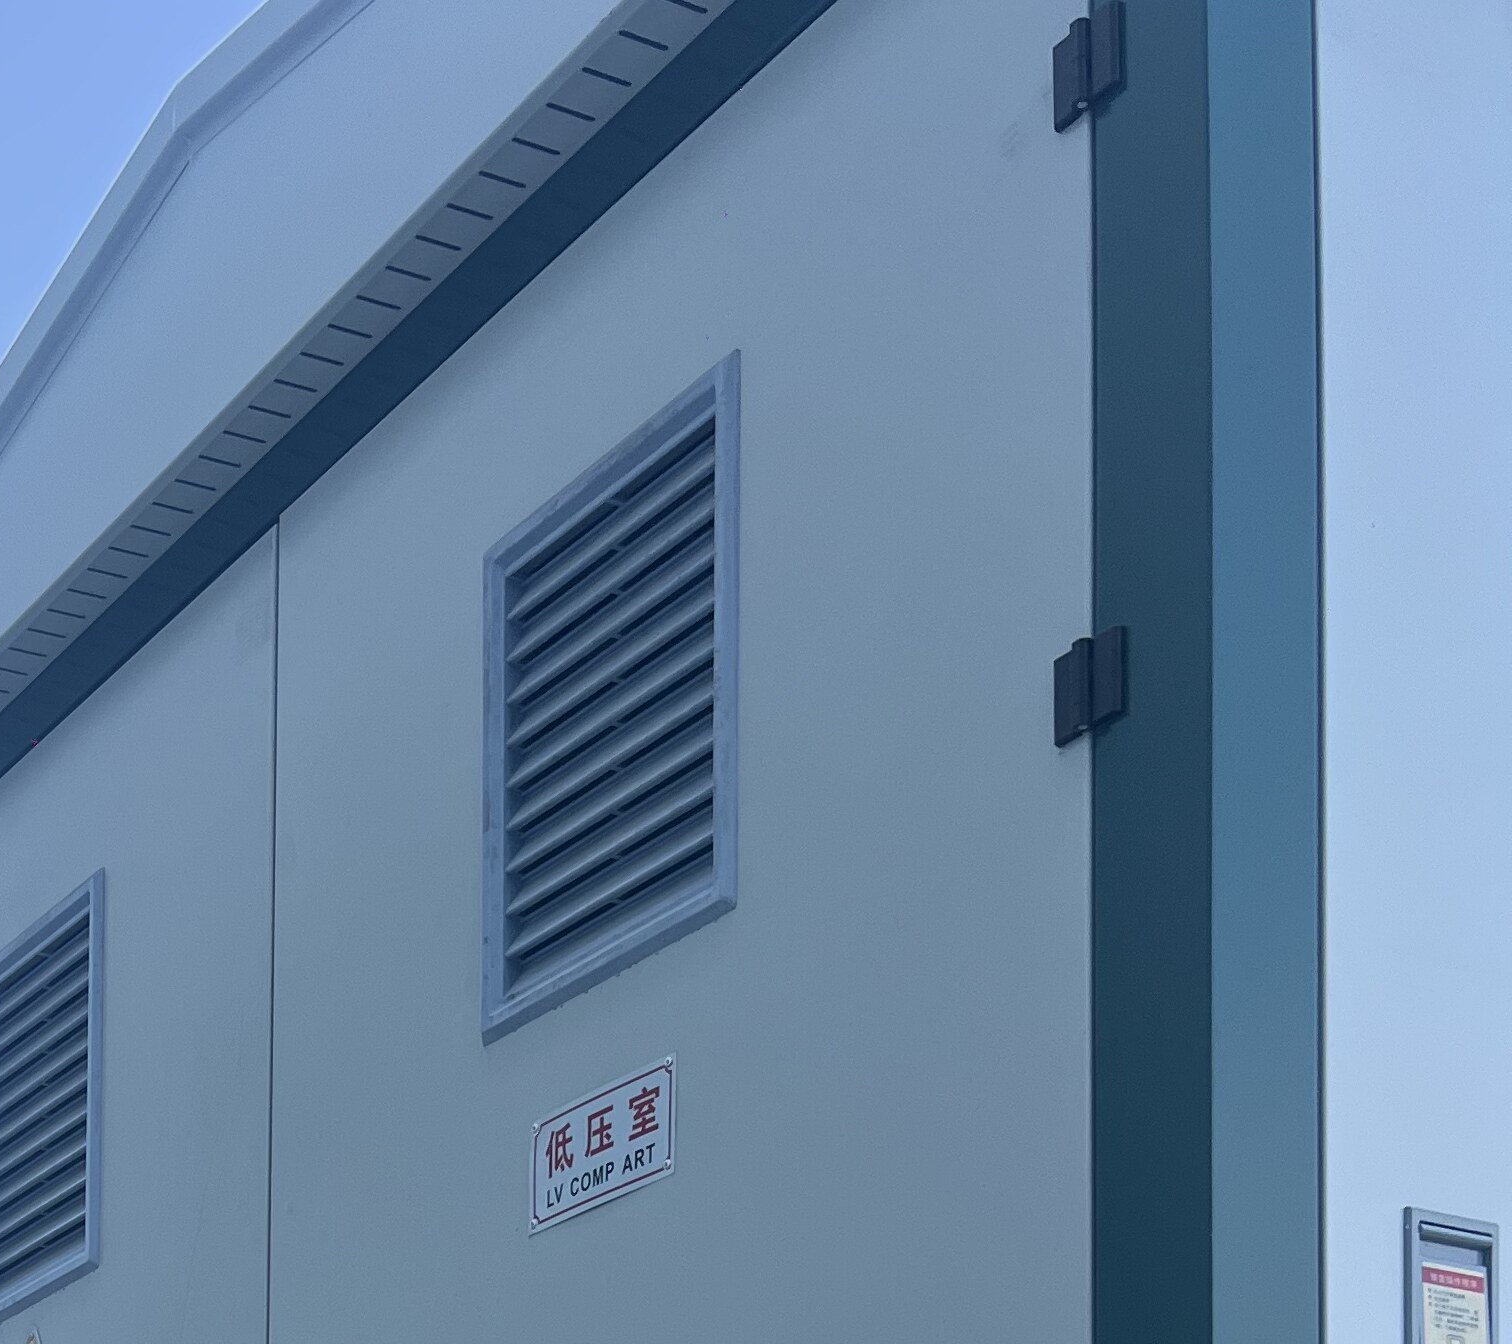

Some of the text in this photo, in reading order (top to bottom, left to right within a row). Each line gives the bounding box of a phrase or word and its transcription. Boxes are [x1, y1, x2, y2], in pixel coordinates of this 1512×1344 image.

[545, 1086, 661, 1179] 低压室
[546, 1142, 656, 1209] LV COMP ART
